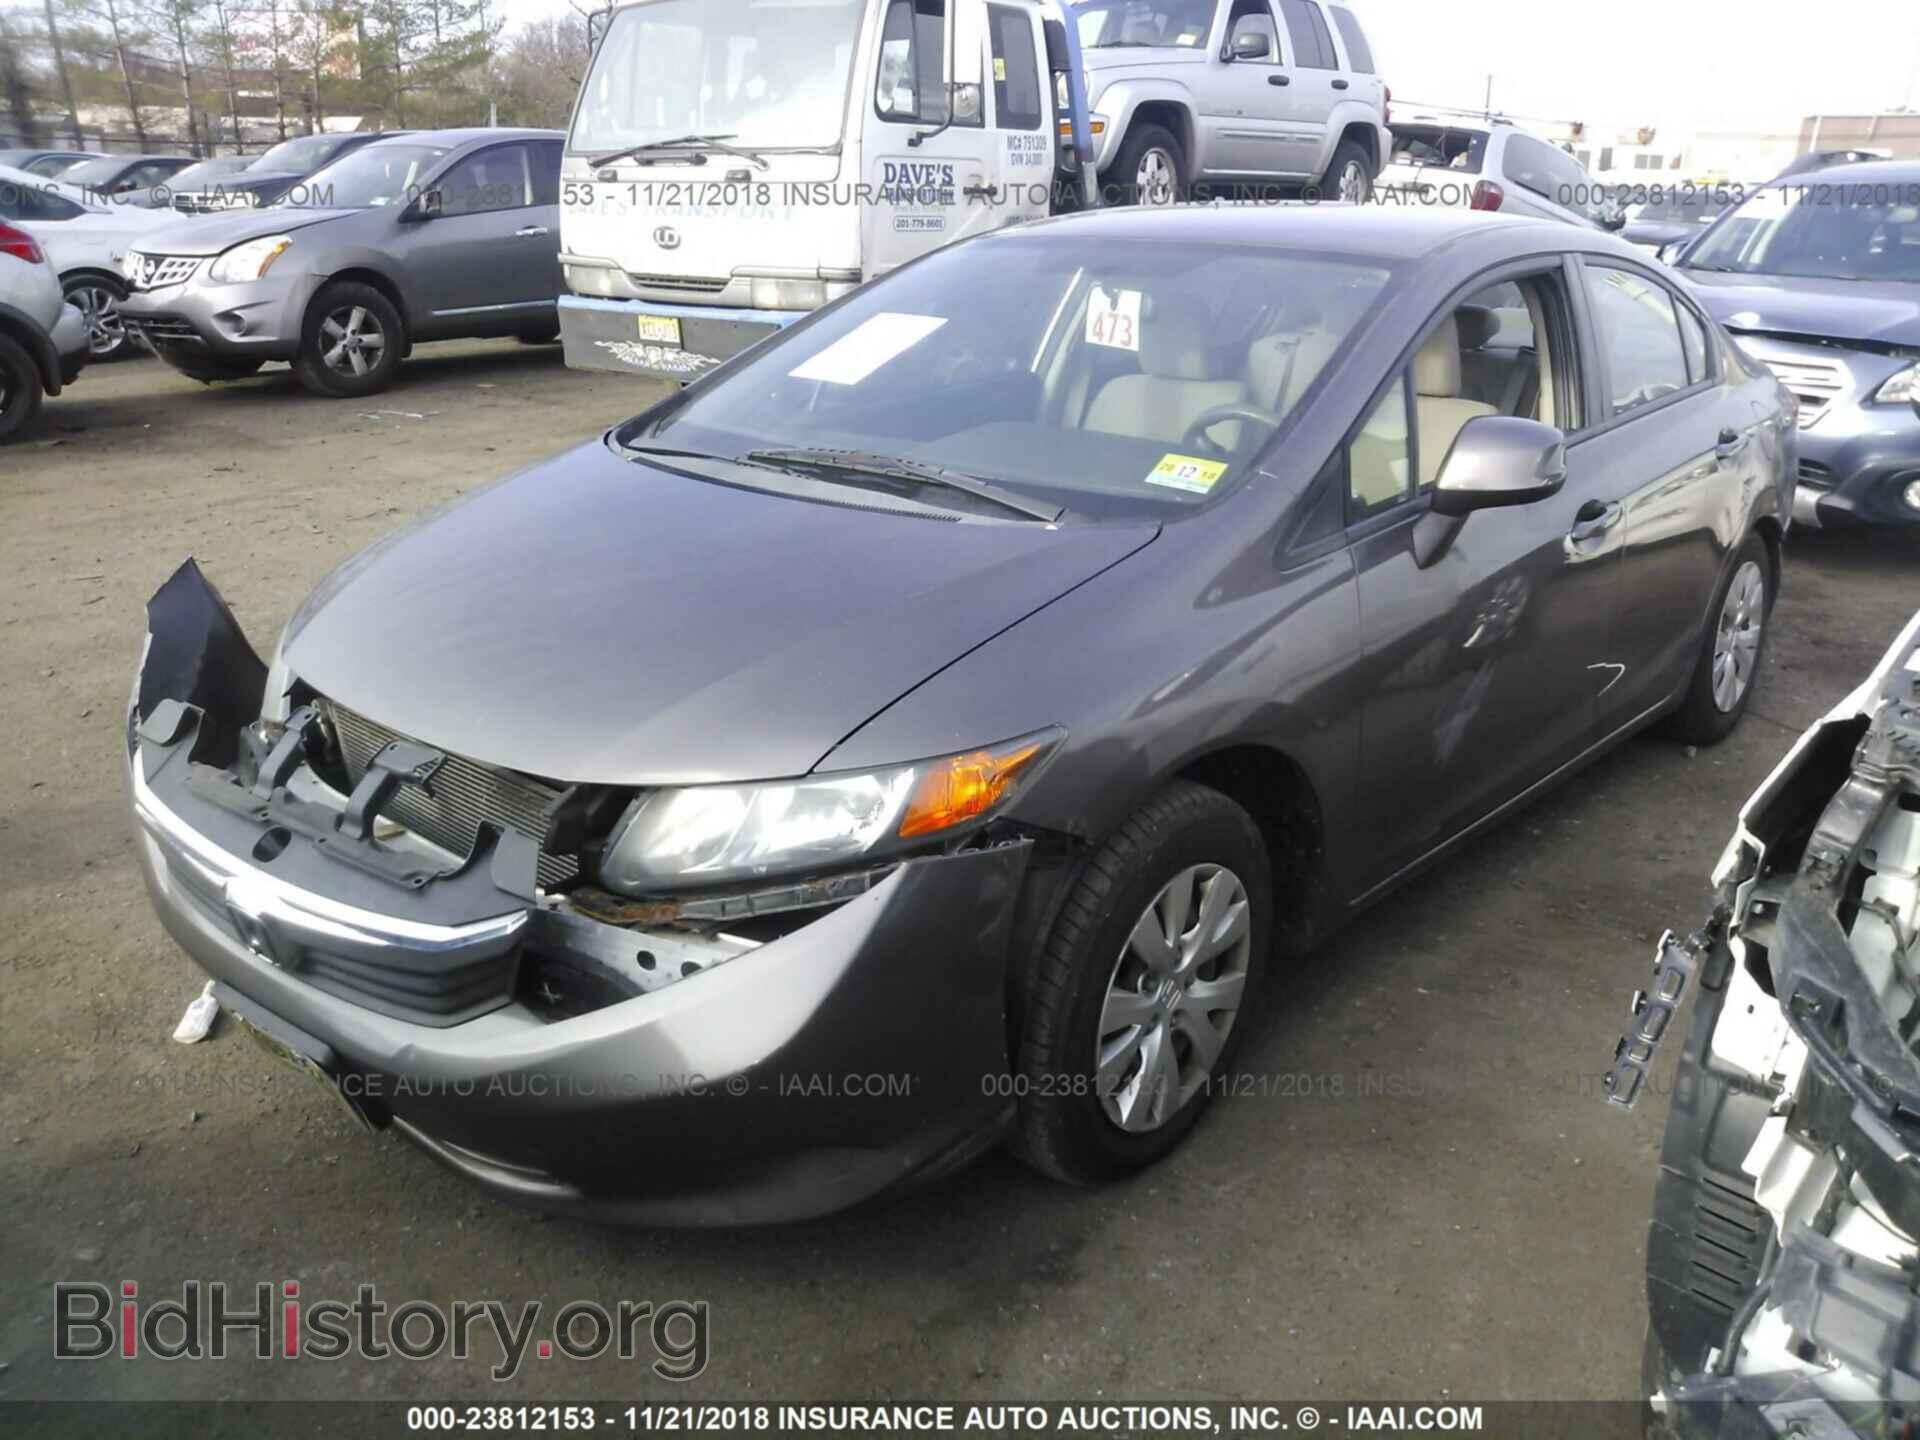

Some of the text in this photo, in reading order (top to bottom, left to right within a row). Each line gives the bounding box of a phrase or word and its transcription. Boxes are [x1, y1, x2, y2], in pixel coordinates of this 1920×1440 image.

[884, 163, 954, 185] DAVE'S
[1092, 312, 1133, 347] 473
[1177, 465, 1198, 478] 12
